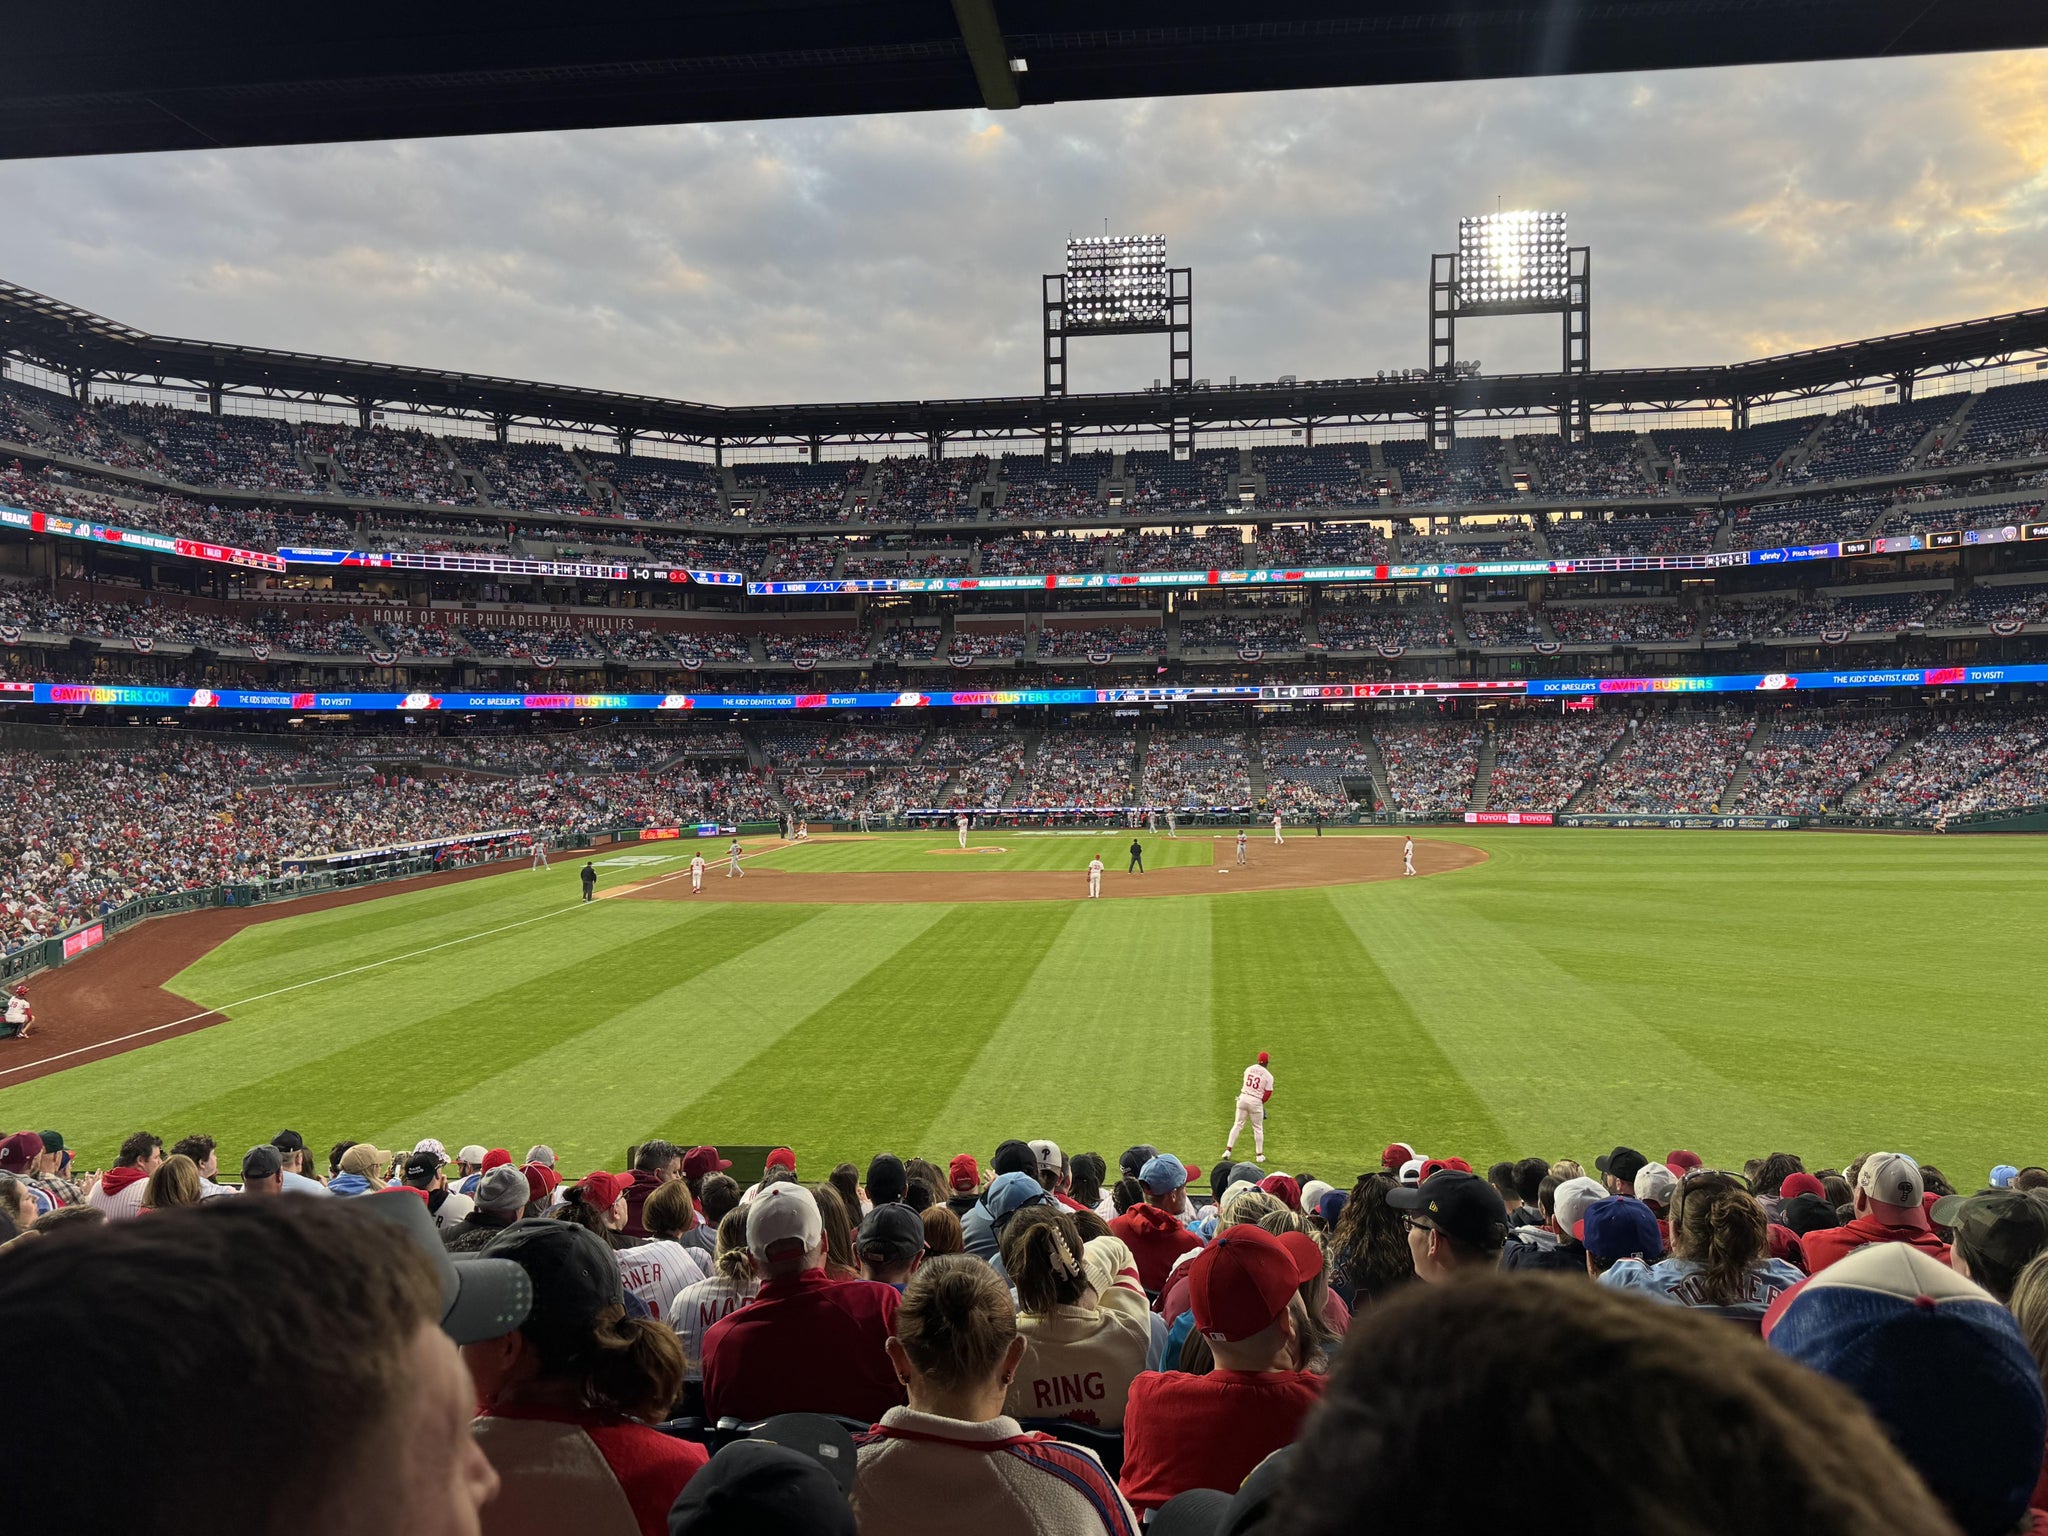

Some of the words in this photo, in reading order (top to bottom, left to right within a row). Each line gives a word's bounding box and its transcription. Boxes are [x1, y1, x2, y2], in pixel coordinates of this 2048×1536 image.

[80, 524, 91, 537] 10
[122, 533, 142, 544] GAME
[142, 537, 154, 546] DAY
[1937, 536, 1952, 544] 7:40
[1792, 549, 1807, 557] Pitch
[1807, 548, 1828, 556] Speed
[1847, 544, 1865, 552] 10:10
[1759, 552, 1781, 561] xfinity
[541, 565, 547, 573] R
[564, 566, 570, 574] H
[586, 567, 591, 575] E
[1428, 566, 1439, 575] 10
[1478, 565, 1501, 573] GAME
[1517, 563, 1548, 571] READY.
[633, 569, 649, 579] 1-0
[1256, 572, 1267, 581] 10
[1343, 569, 1373, 577] READY.
[1092, 576, 1103, 585] 10
[1178, 575, 1205, 583] READY.
[933, 580, 943, 589] 10
[374, 610, 413, 623] HOME
[420, 612, 436, 623] OF
[444, 612, 469, 625] THE
[478, 613, 571, 627] PHILADELPHIA
[1925, 667, 1966, 685] LOVE
[1982, 671, 2004, 679] VISIT!
[1544, 683, 1561, 691] DOC
[1561, 682, 1596, 691] BRESLER'S
[1599, 680, 1649, 691] CAVITY
[1653, 679, 1713, 690] BUSTERS
[50, 686, 170, 703] CAVITYBUSTERS.COM
[1303, 688, 1320, 696] OUTS
[239, 695, 249, 703] THE
[280, 697, 290, 705] KIDS
[320, 698, 331, 706] TO
[331, 698, 352, 706] VISIT!
[469, 697, 486, 706] DOC
[487, 697, 521, 706] BRESLER'S
[523, 696, 571, 707] CAVITY
[574, 696, 628, 707] BUSTERS
[723, 698, 734, 706] THE
[735, 698, 750, 706] KIDS'
[750, 698, 776, 706] DENTIST,
[777, 697, 791, 705] KIDS
[795, 694, 827, 708] LOVE
[841, 697, 857, 705] VISIT!
[952, 692, 1081, 704] CAVITYBUSTERS.COM
[1479, 814, 1507, 822] TOYOTA
[1567, 819, 1578, 827] 10
[1669, 819, 1681, 828] 10
[1722, 819, 1734, 828] 10
[1776, 820, 1789, 828] 10
[1245, 1074, 1261, 1090] 53
[1041, 1148, 1050, 1161] P
[1898, 1181, 1913, 1202] P
[621, 1263, 662, 1291] RNER
[1666, 1273, 1783, 1309] TUER
[1033, 1371, 1105, 1410] RING
